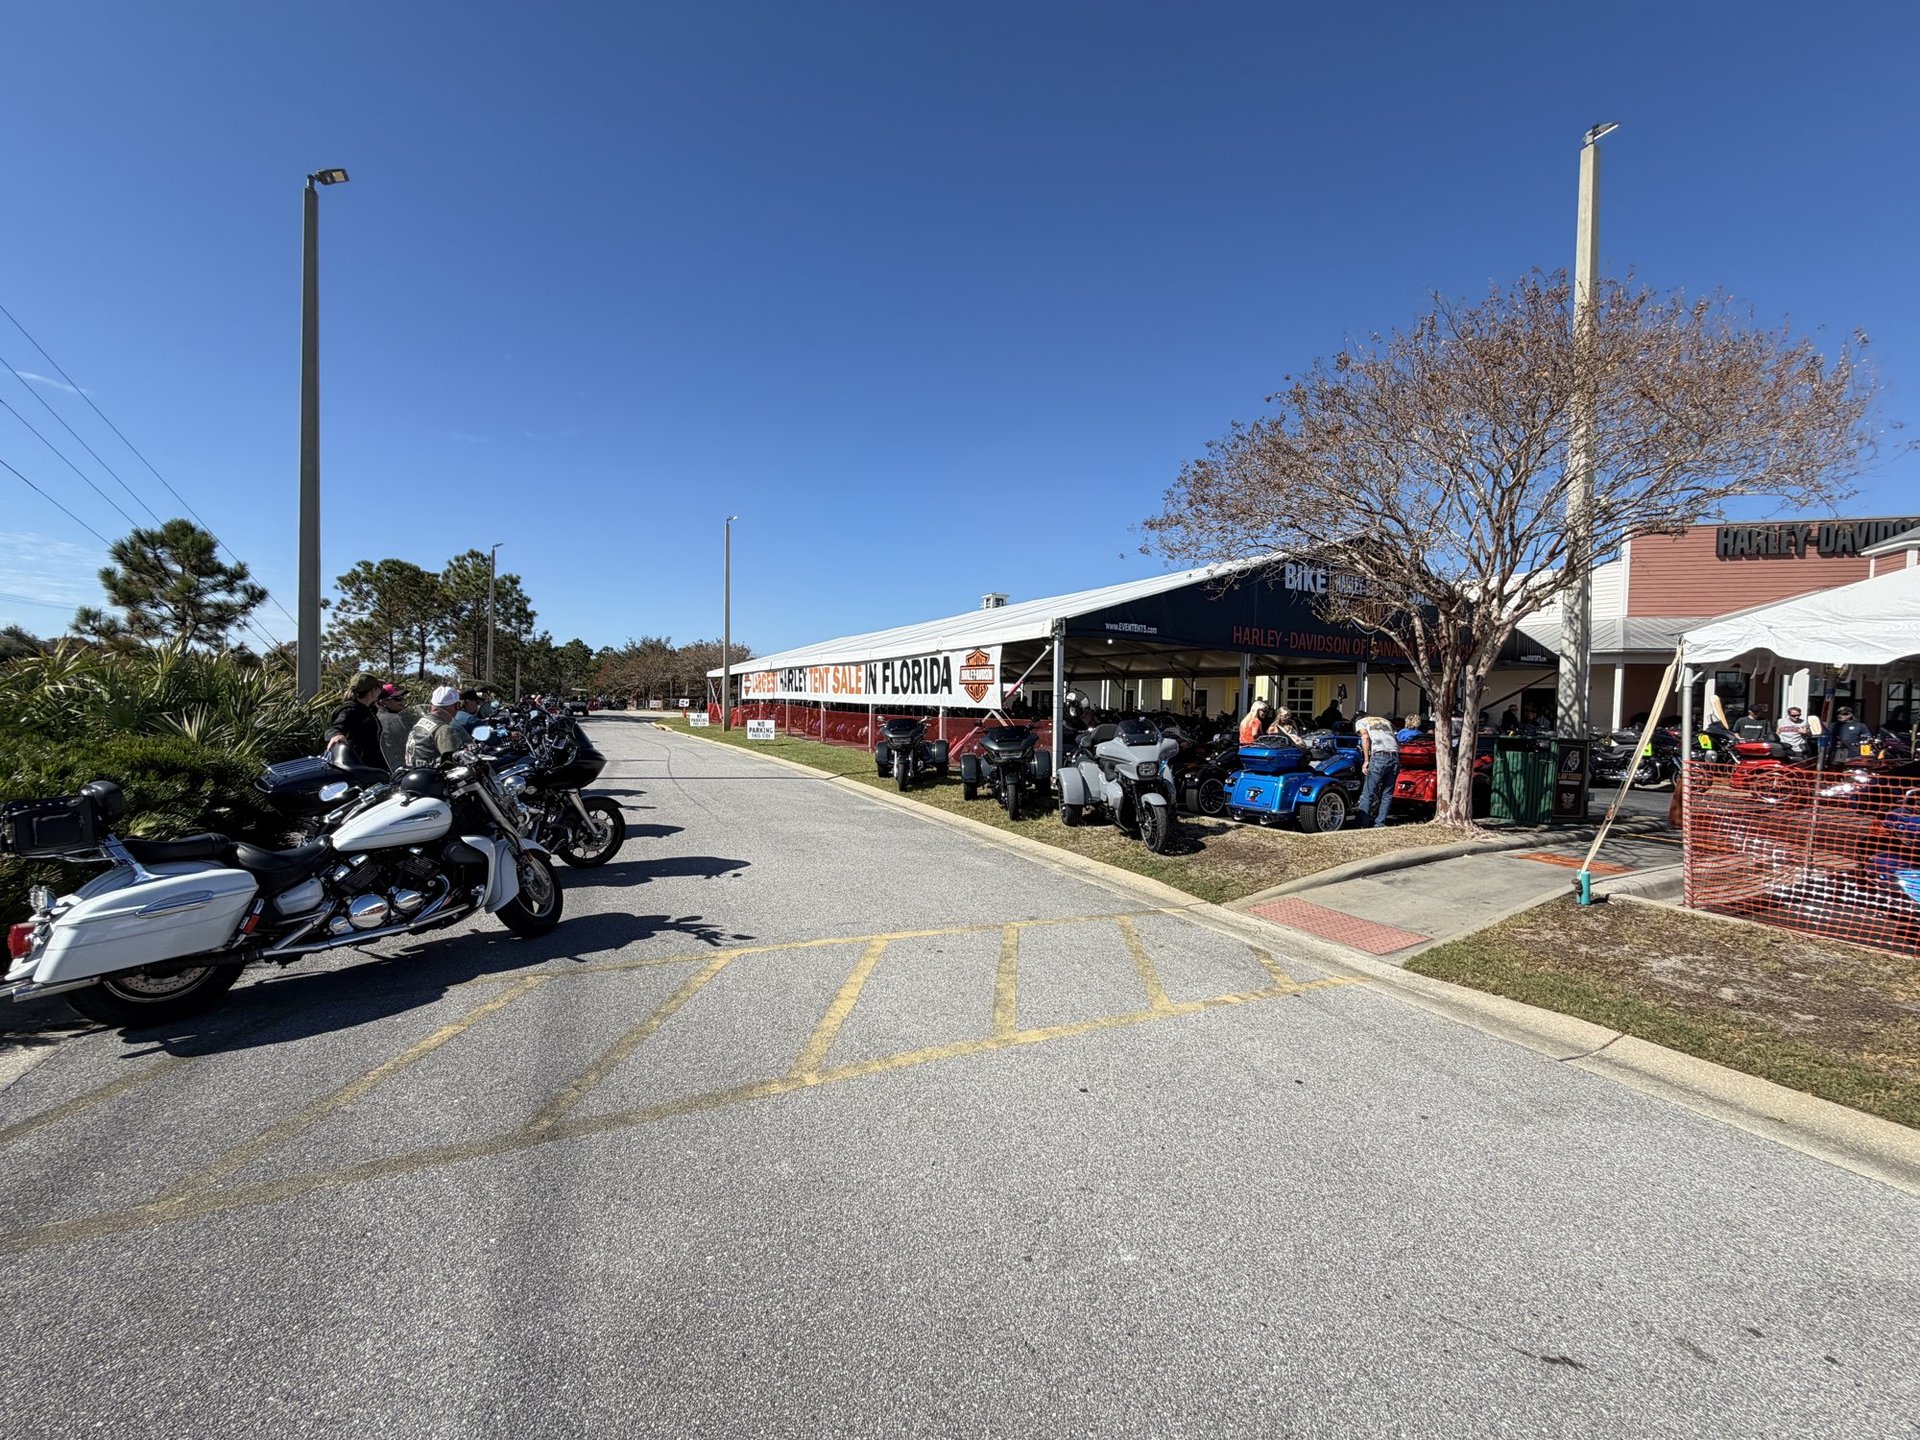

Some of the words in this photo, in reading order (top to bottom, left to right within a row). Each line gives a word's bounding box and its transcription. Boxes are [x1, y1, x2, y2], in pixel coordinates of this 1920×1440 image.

[1285, 563, 1327, 594] BIKE
[1352, 638, 1367, 656] OF
[752, 671, 778, 693] LARGEST
[809, 666, 830, 693] TENT
[832, 665, 862, 694] SALE
[865, 663, 877, 694] IN
[882, 656, 952, 695] FLORIDA
